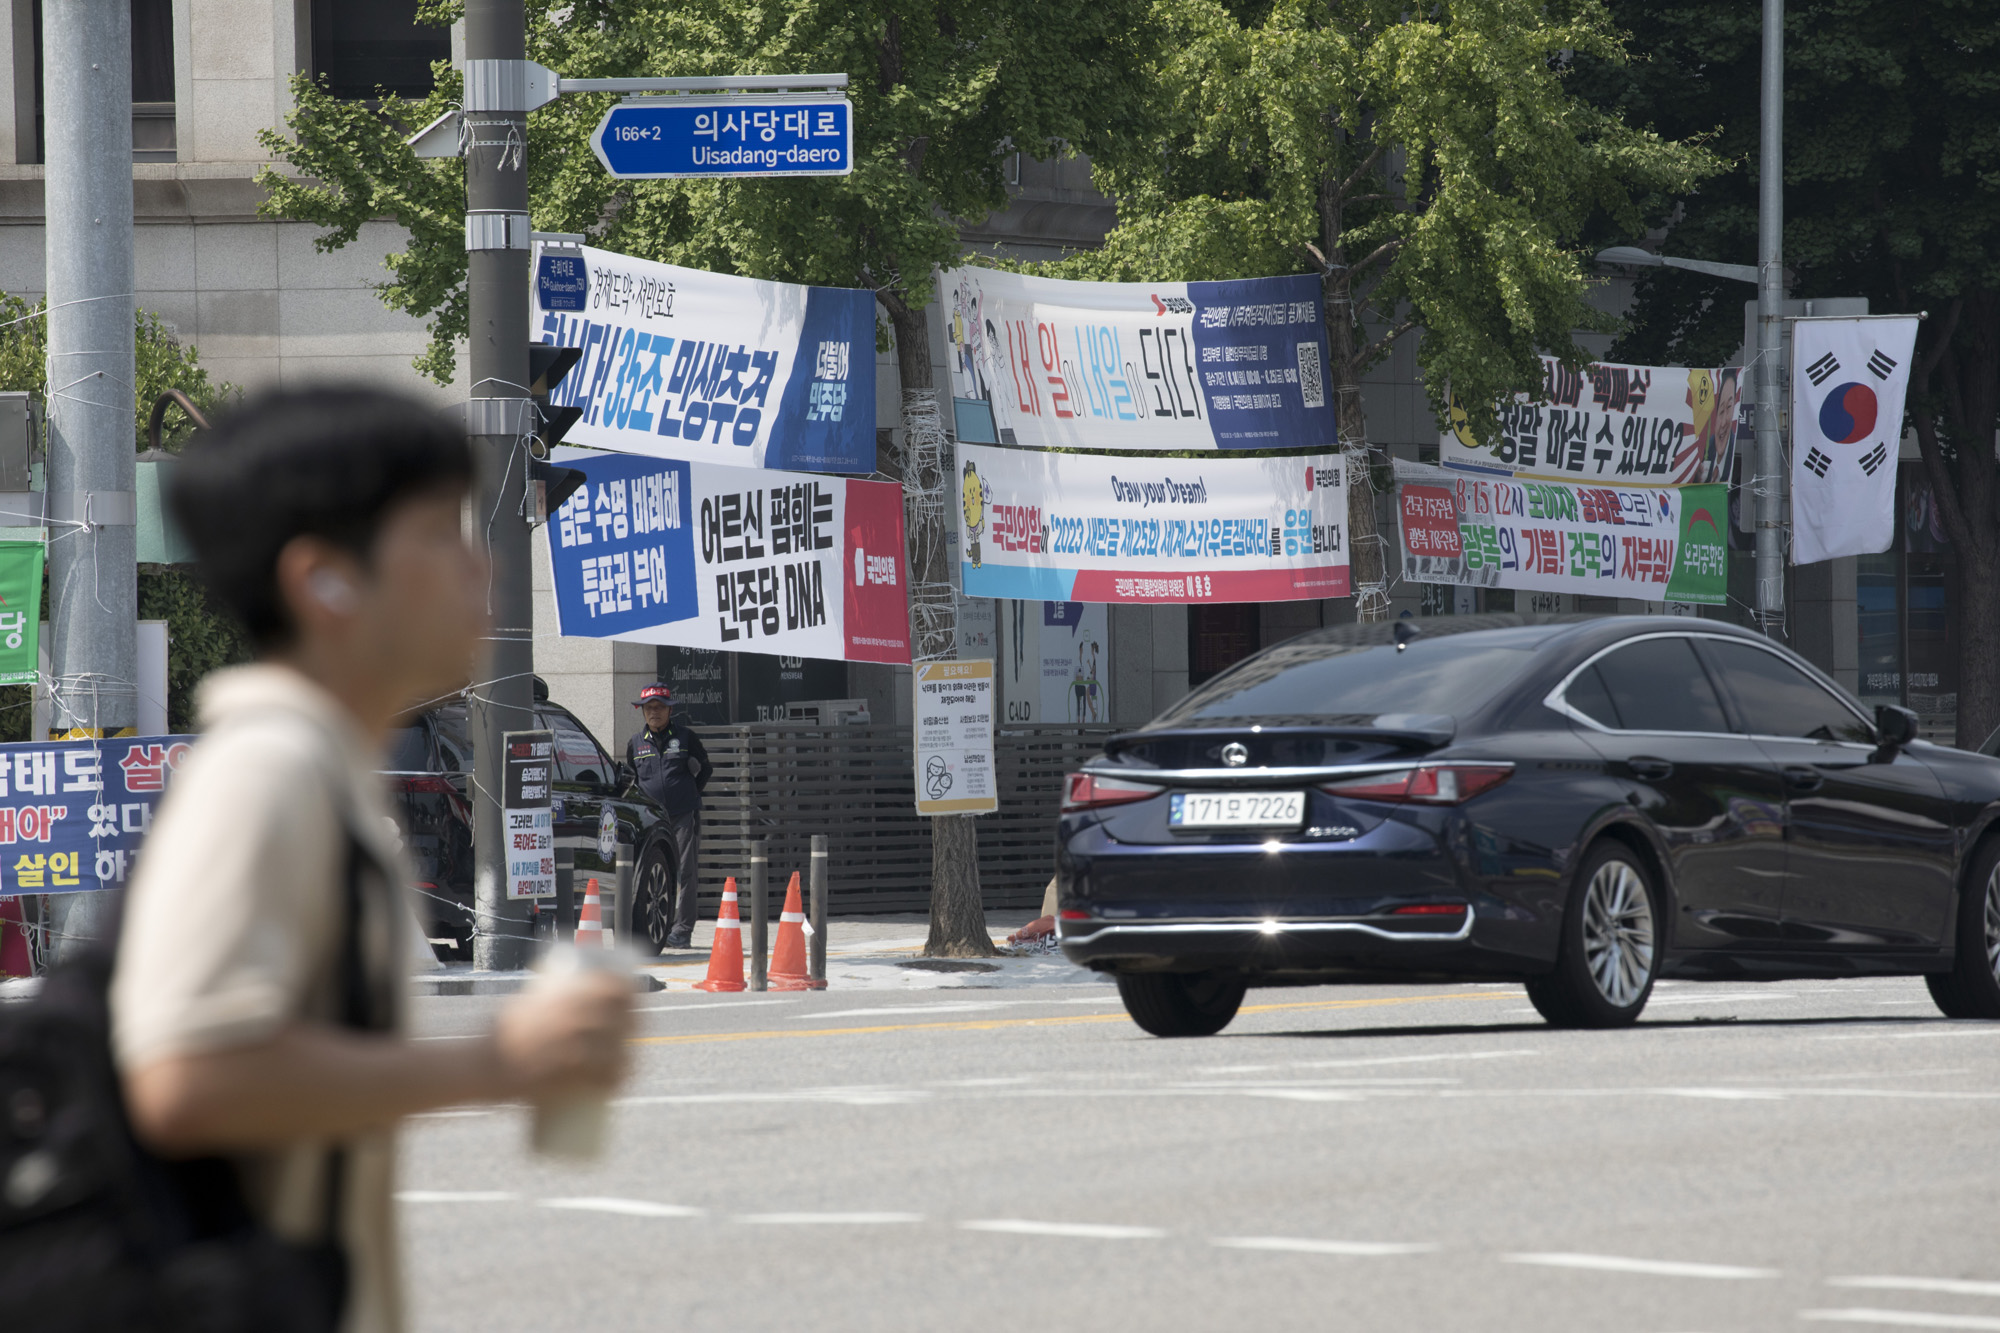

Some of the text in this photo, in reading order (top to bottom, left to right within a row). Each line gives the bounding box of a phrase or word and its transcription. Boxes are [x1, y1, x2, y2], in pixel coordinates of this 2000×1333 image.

[614, 126, 661, 141] 166 2
[693, 111, 841, 142] 의사당대로
[692, 145, 841, 168] Uisadang-daero
[550, 260, 575, 277] 국회대로
[1200, 306, 1231, 328] 국민의힘
[815, 341, 850, 381] 더불어
[1075, 324, 1149, 421] 내일이
[1139, 327, 1202, 421] 되다
[603, 327, 675, 432] 35조
[657, 339, 779, 447] 민생추경
[805, 382, 848, 422] 민주당
[1499, 405, 1684, 476] 정말 마실 수 있나요?
[1111, 475, 1208, 508] Draw your Dream!
[1315, 469, 1341, 488] 국민의힘
[595, 479, 629, 542] 수명
[631, 470, 681, 536] 비례해
[1404, 494, 1454, 521] 건국 75주년
[1494, 482, 1524, 518] 12시
[1522, 483, 1579, 522] 모이자!
[1580, 487, 1653, 528] 숭례문으로!
[701, 481, 833, 564] 어르신 폄훼는
[992, 504, 1049, 554] 국민의힘이
[1084, 517, 1119, 557] 새만금
[1120, 519, 1159, 558] 제25회
[1283, 508, 1341, 555] 응원합니다
[1409, 527, 1460, 553] 광복 78주년
[1460, 523, 1674, 585] 광복의 기쁨! 건국의 자부심!
[867, 555, 897, 586] 국민의힘
[1683, 543, 1724, 578] 우리공화당
[581, 544, 669, 618] 투표권 부여
[716, 560, 826, 643] 민주당 DNA
[943, 665, 973, 676] 필요해요!
[1009, 701, 1031, 721] CALD
[1247, 797, 1298, 819] 7226
[513, 833, 538, 850] 죽여도
[14, 852, 80, 887] 살인
